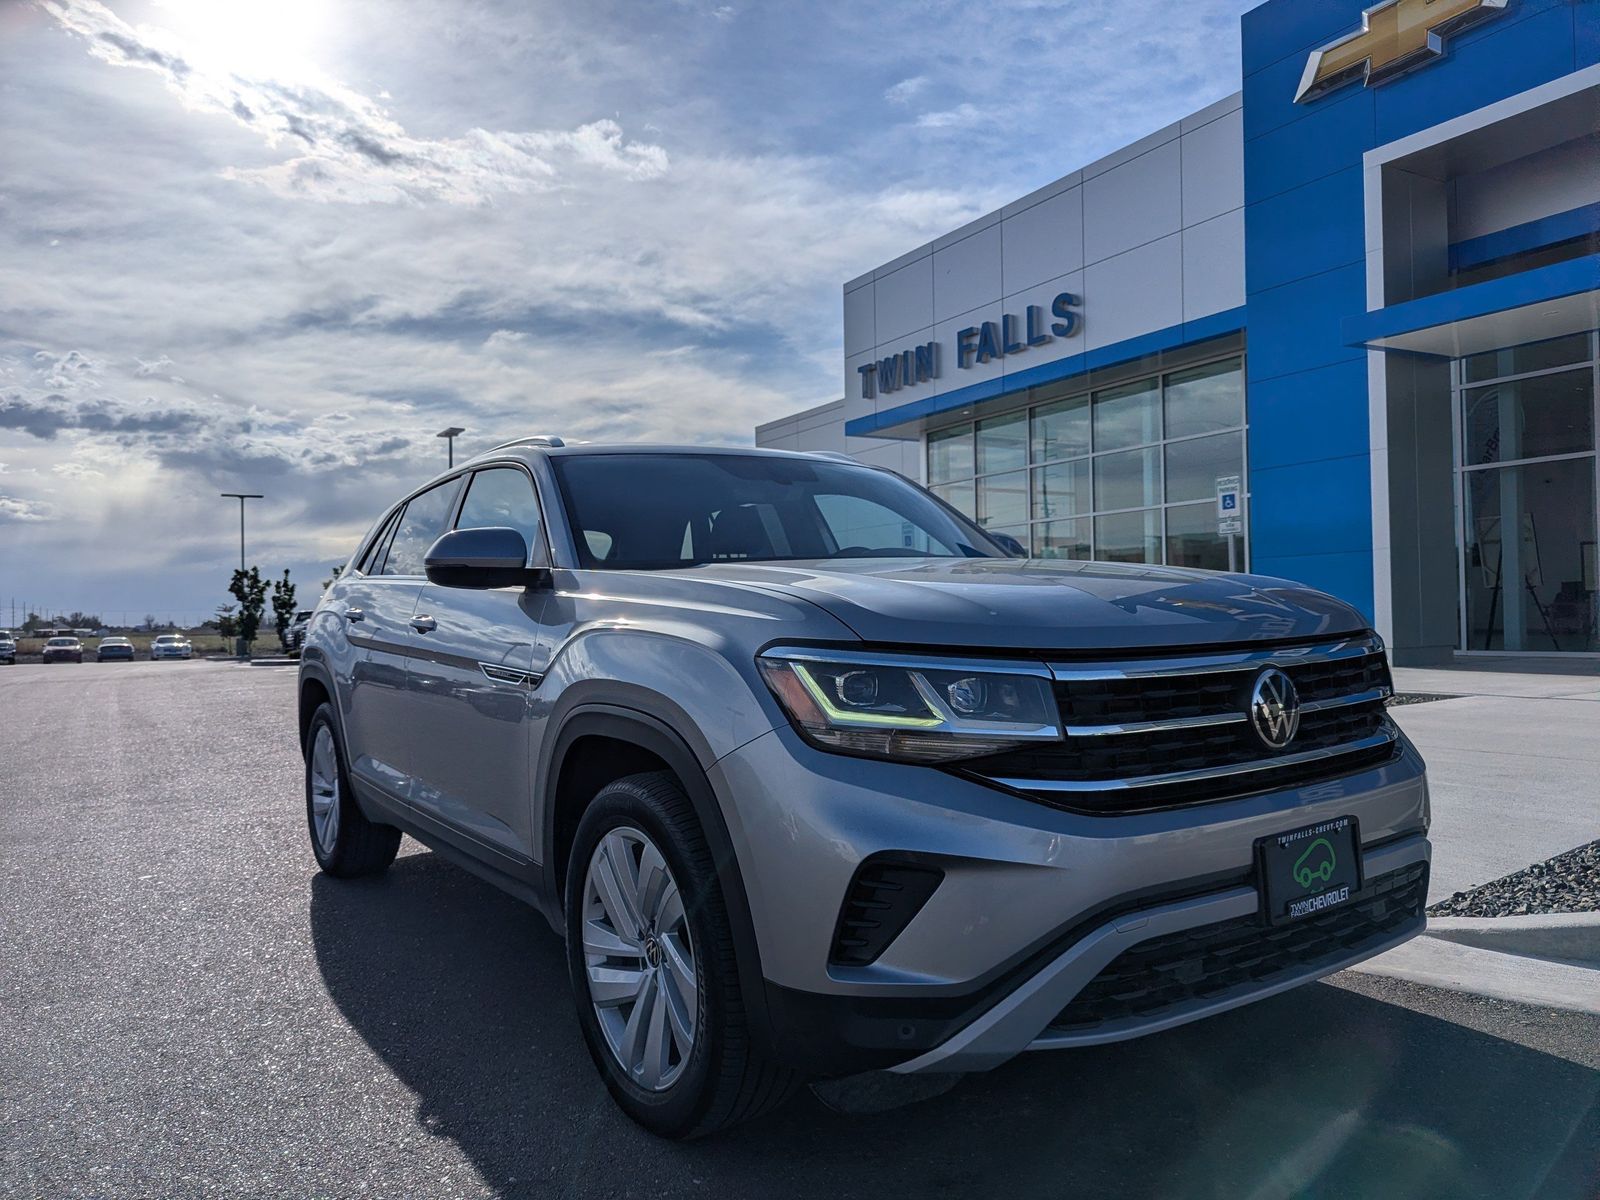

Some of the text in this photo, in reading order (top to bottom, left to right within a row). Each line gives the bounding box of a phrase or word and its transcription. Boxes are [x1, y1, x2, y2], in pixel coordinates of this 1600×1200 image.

[857, 292, 1082, 399] TWIN FALLS
[1308, 887, 1349, 911] CHEVROLET
